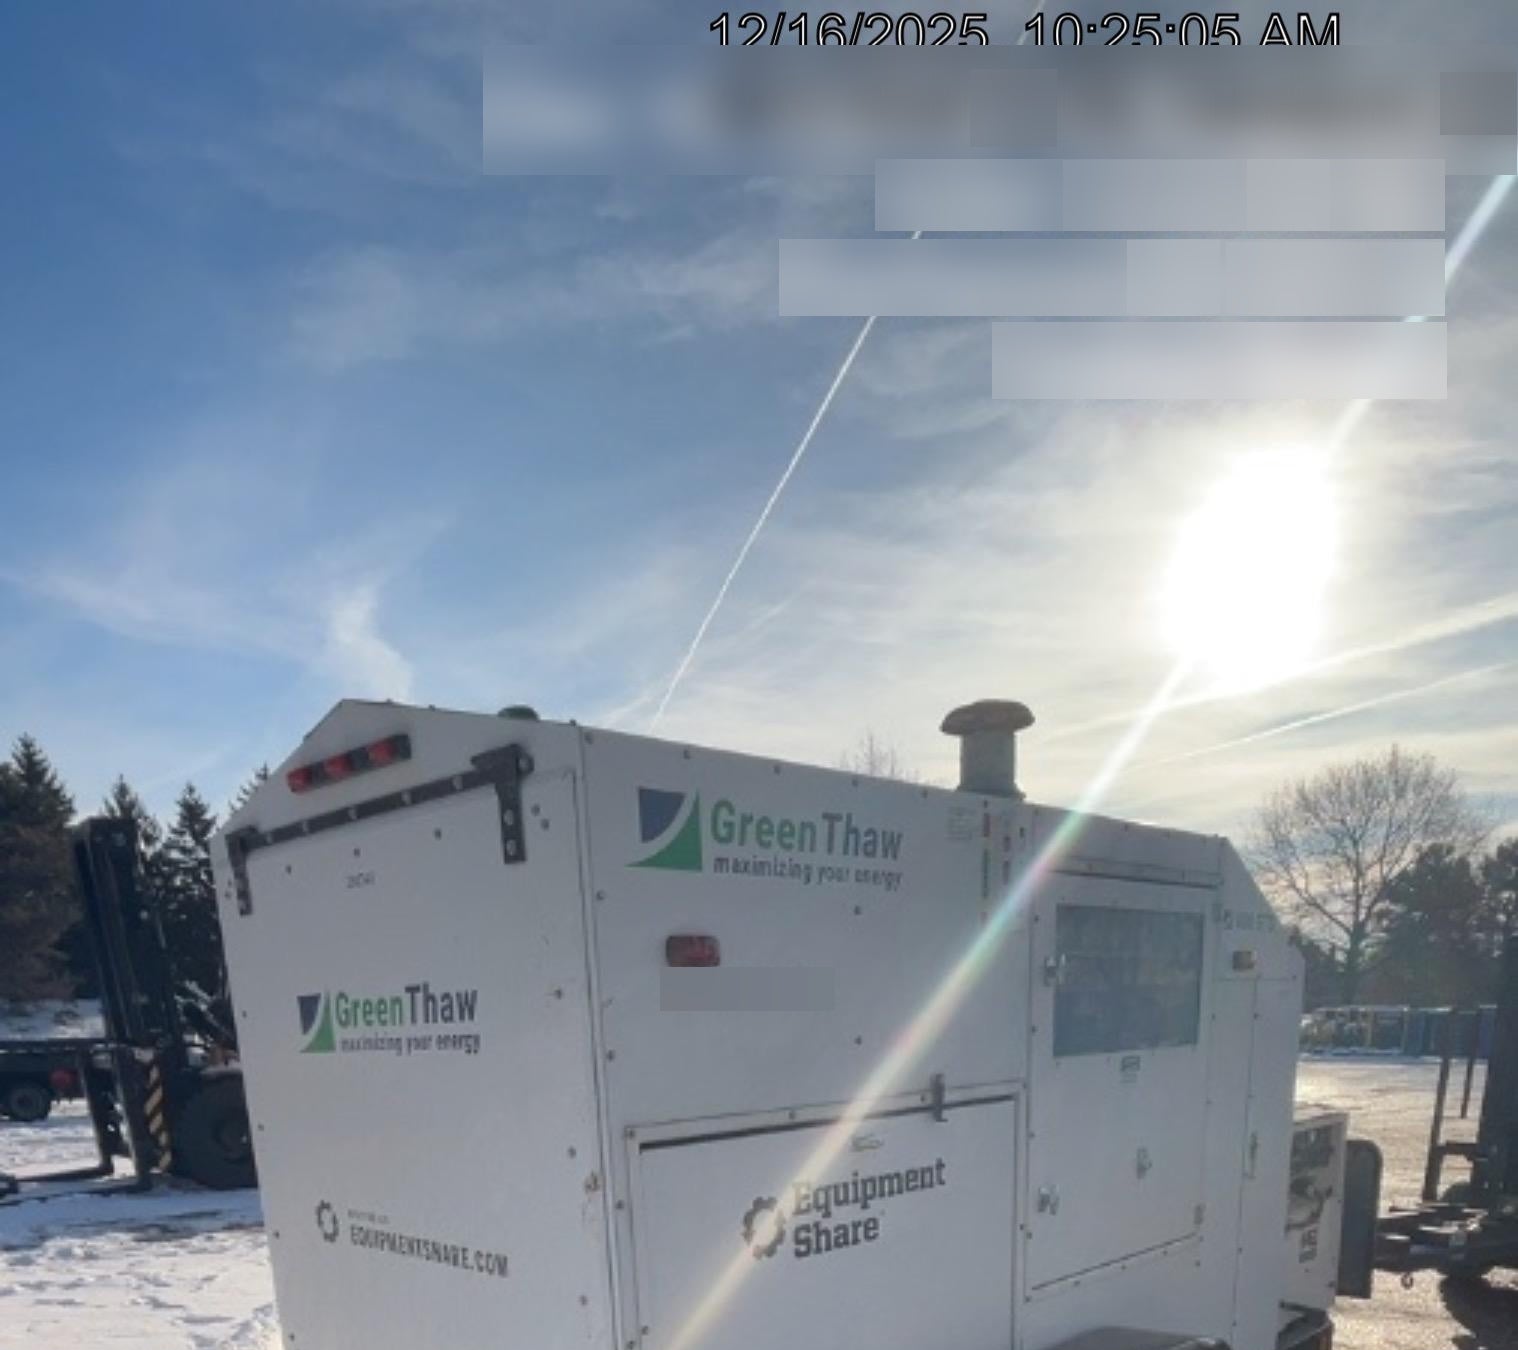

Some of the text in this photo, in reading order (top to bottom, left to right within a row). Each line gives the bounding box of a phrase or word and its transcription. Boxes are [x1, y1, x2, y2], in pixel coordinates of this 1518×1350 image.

[710, 799, 904, 861] GreenThaw
[713, 855, 904, 892] maximizing your energy
[335, 983, 479, 1027] GreenThaw
[341, 1032, 481, 1055] maximizing your energy
[793, 1158, 946, 1218] Equipment
[793, 1216, 880, 1258] Share
